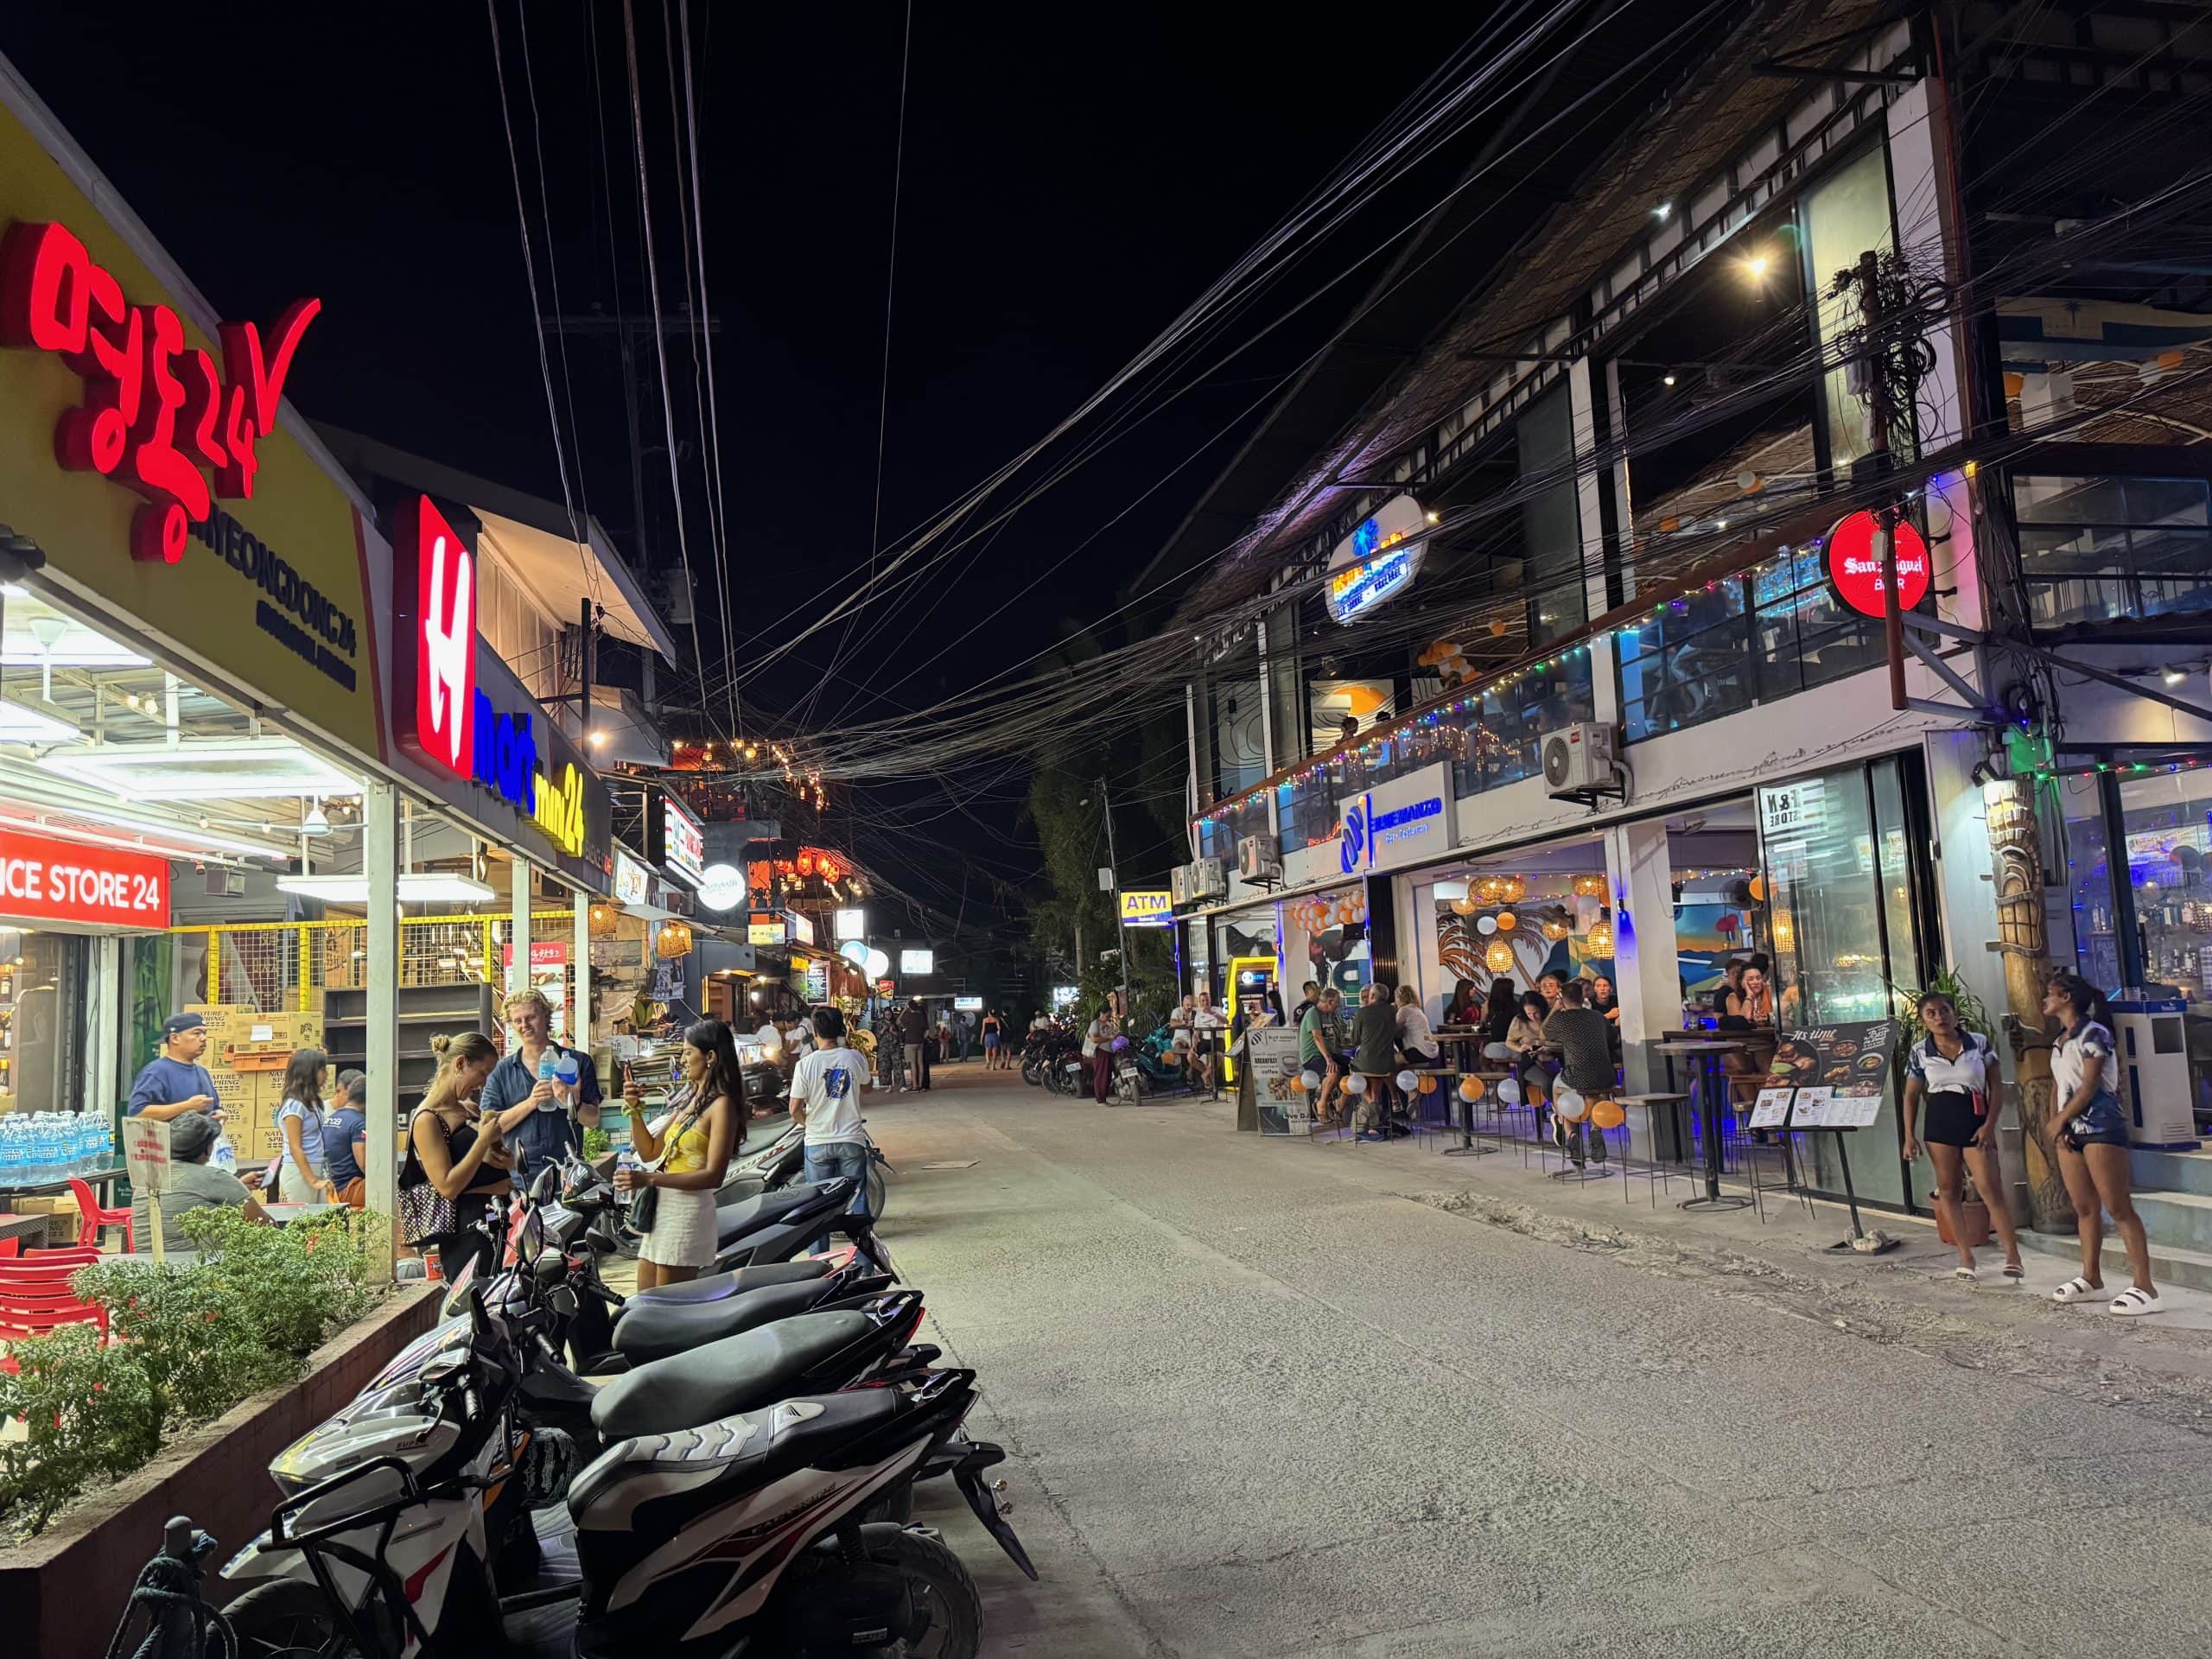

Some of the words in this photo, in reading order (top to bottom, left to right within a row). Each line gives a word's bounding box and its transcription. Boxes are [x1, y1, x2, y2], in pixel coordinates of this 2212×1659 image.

[1844, 557, 1877, 575] San
[426, 536, 470, 767] H
[473, 687, 537, 817] mart
[48, 864, 130, 908] STORE
[1126, 895, 1166, 910] ATM
